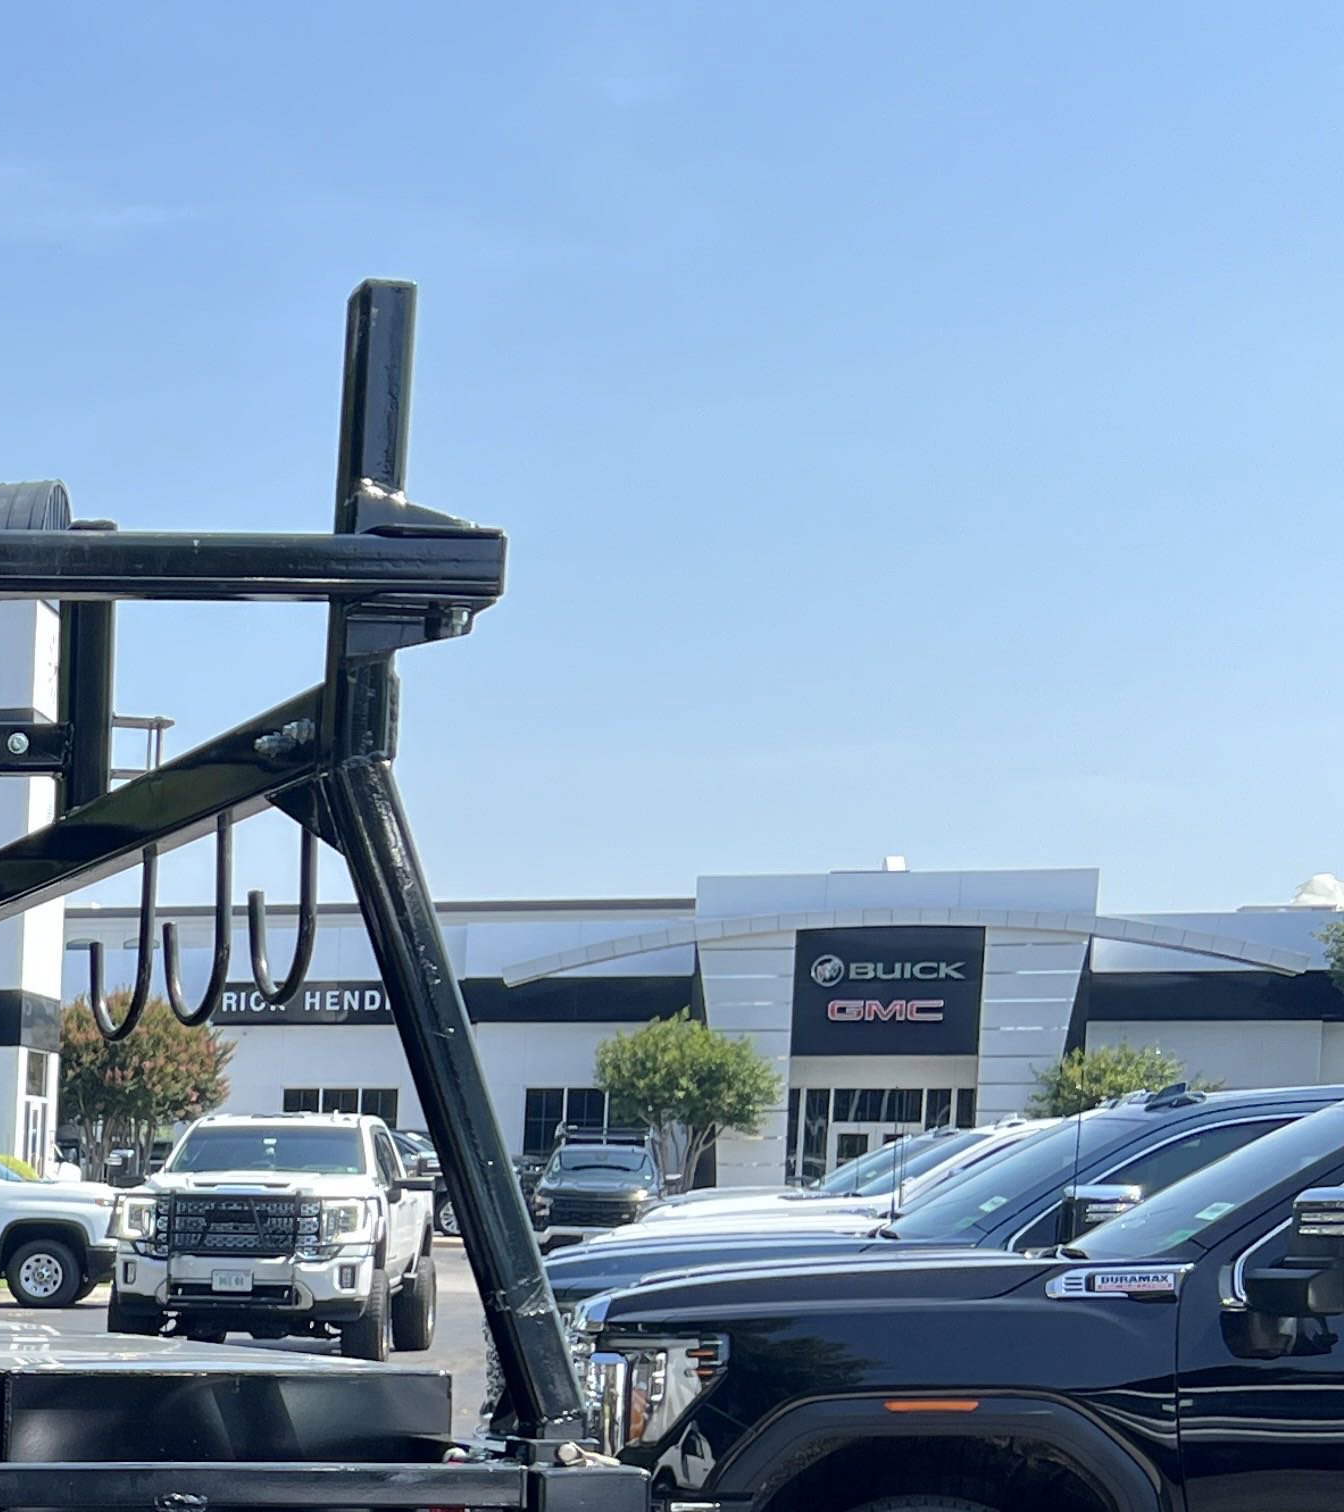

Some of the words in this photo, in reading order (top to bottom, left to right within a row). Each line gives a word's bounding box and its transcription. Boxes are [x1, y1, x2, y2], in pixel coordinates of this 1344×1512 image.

[849, 962, 967, 980] BUICK
[304, 989, 391, 1012] HEND
[827, 999, 944, 1021] GMC
[1100, 1274, 1169, 1285] DURAMAX
